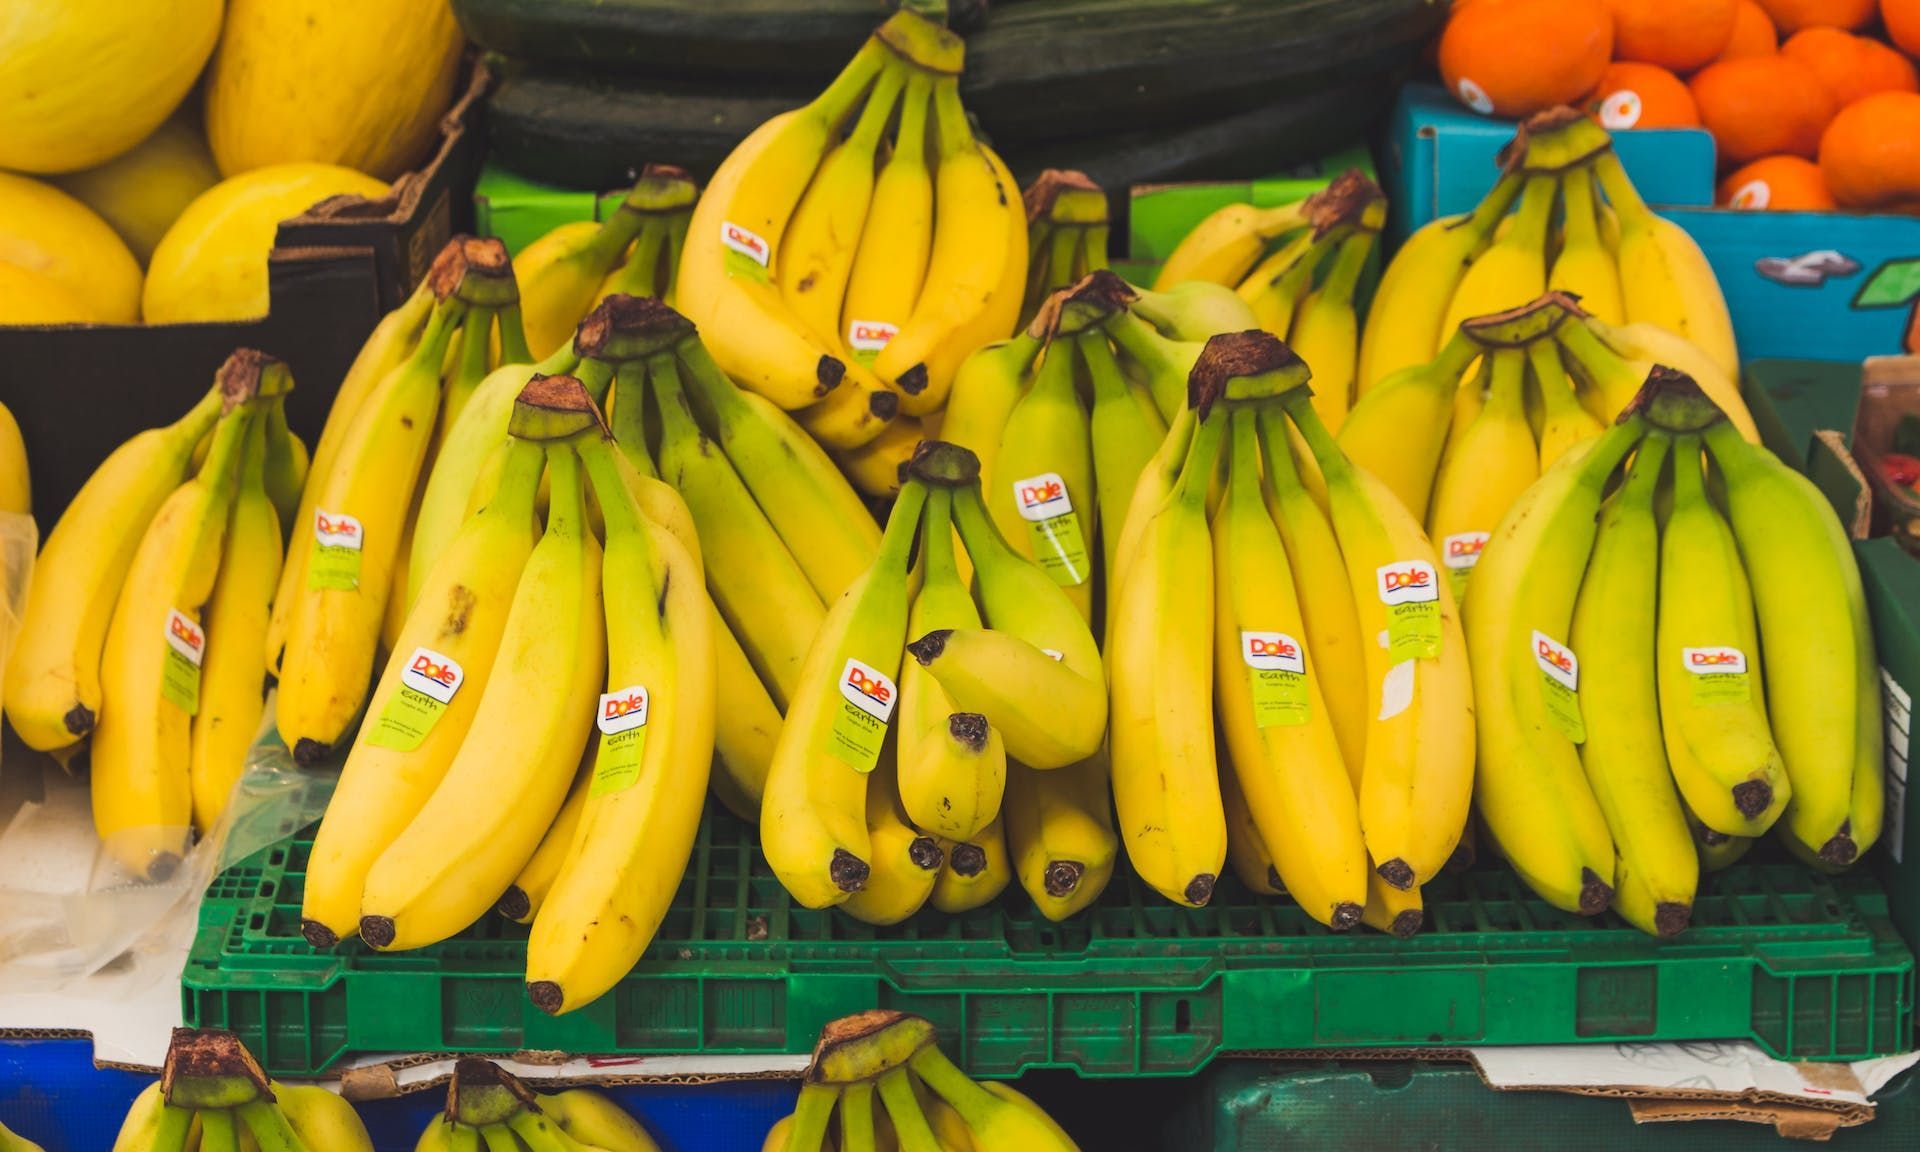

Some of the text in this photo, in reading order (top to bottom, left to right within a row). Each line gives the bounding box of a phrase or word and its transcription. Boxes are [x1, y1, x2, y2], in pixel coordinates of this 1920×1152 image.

[728, 227, 762, 253] Dole
[1022, 481, 1061, 505] Dole
[319, 514, 356, 535] Dole
[1385, 568, 1429, 589] Dole
[1250, 638, 1296, 656] Dole
[1538, 639, 1572, 672] Dole
[1691, 652, 1737, 665] Dole
[413, 655, 457, 685] Dole
[848, 667, 890, 702] Dole
[605, 694, 643, 718] Dole
